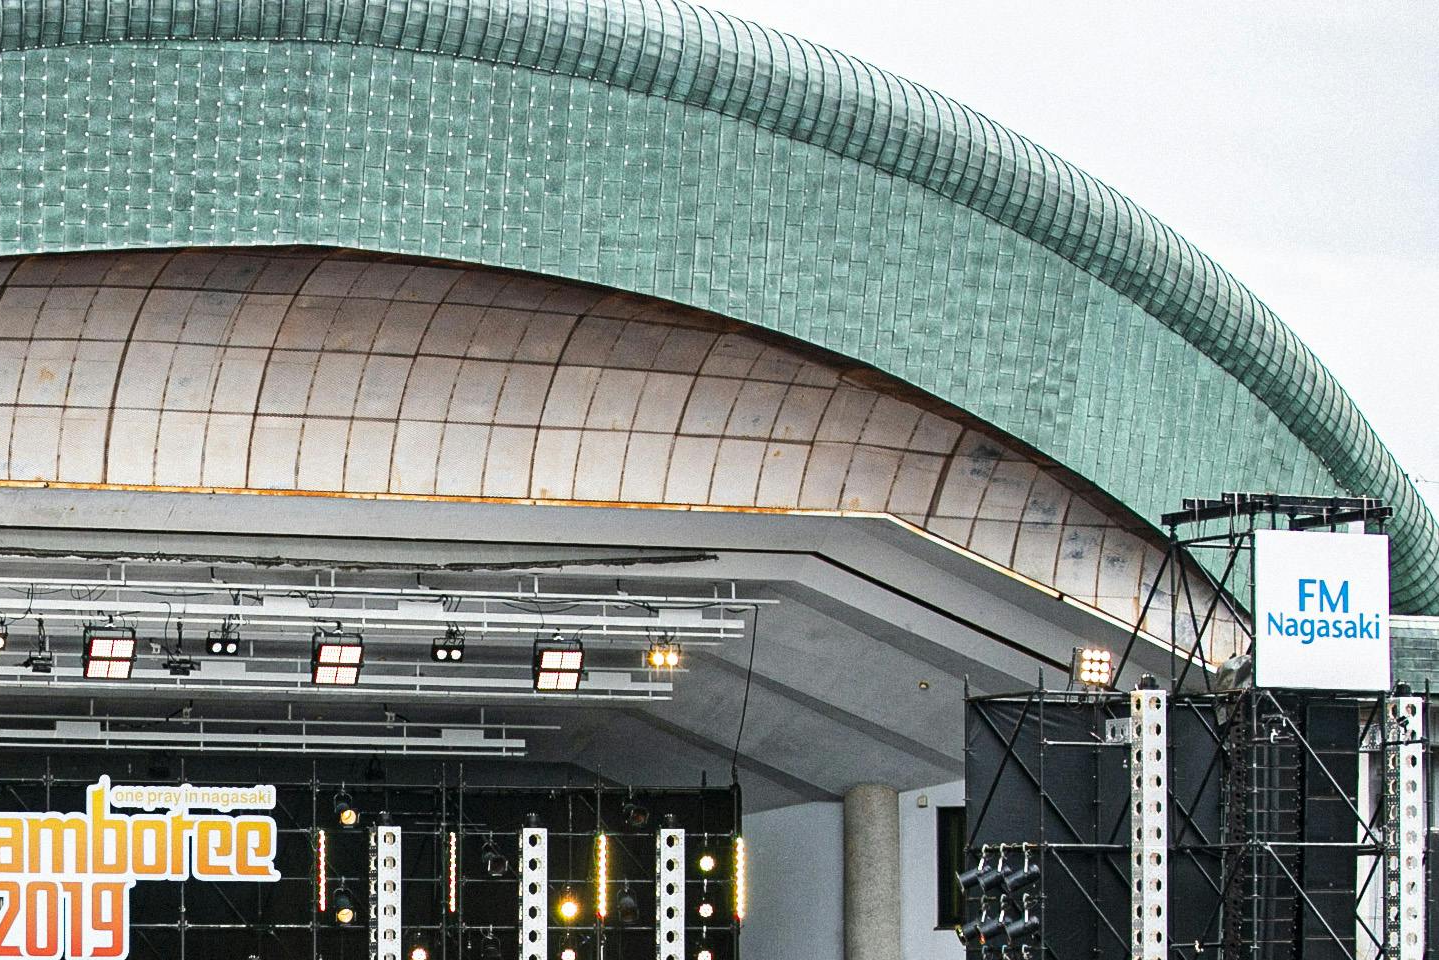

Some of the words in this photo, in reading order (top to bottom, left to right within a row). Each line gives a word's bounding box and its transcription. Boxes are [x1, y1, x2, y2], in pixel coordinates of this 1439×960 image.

[1298, 578, 1349, 613] FM
[1267, 612, 1380, 645] Nagasaki
[115, 790, 143, 802] one
[147, 790, 181, 807] pray
[184, 788, 199, 803] in
[200, 789, 272, 807] nagasaki
